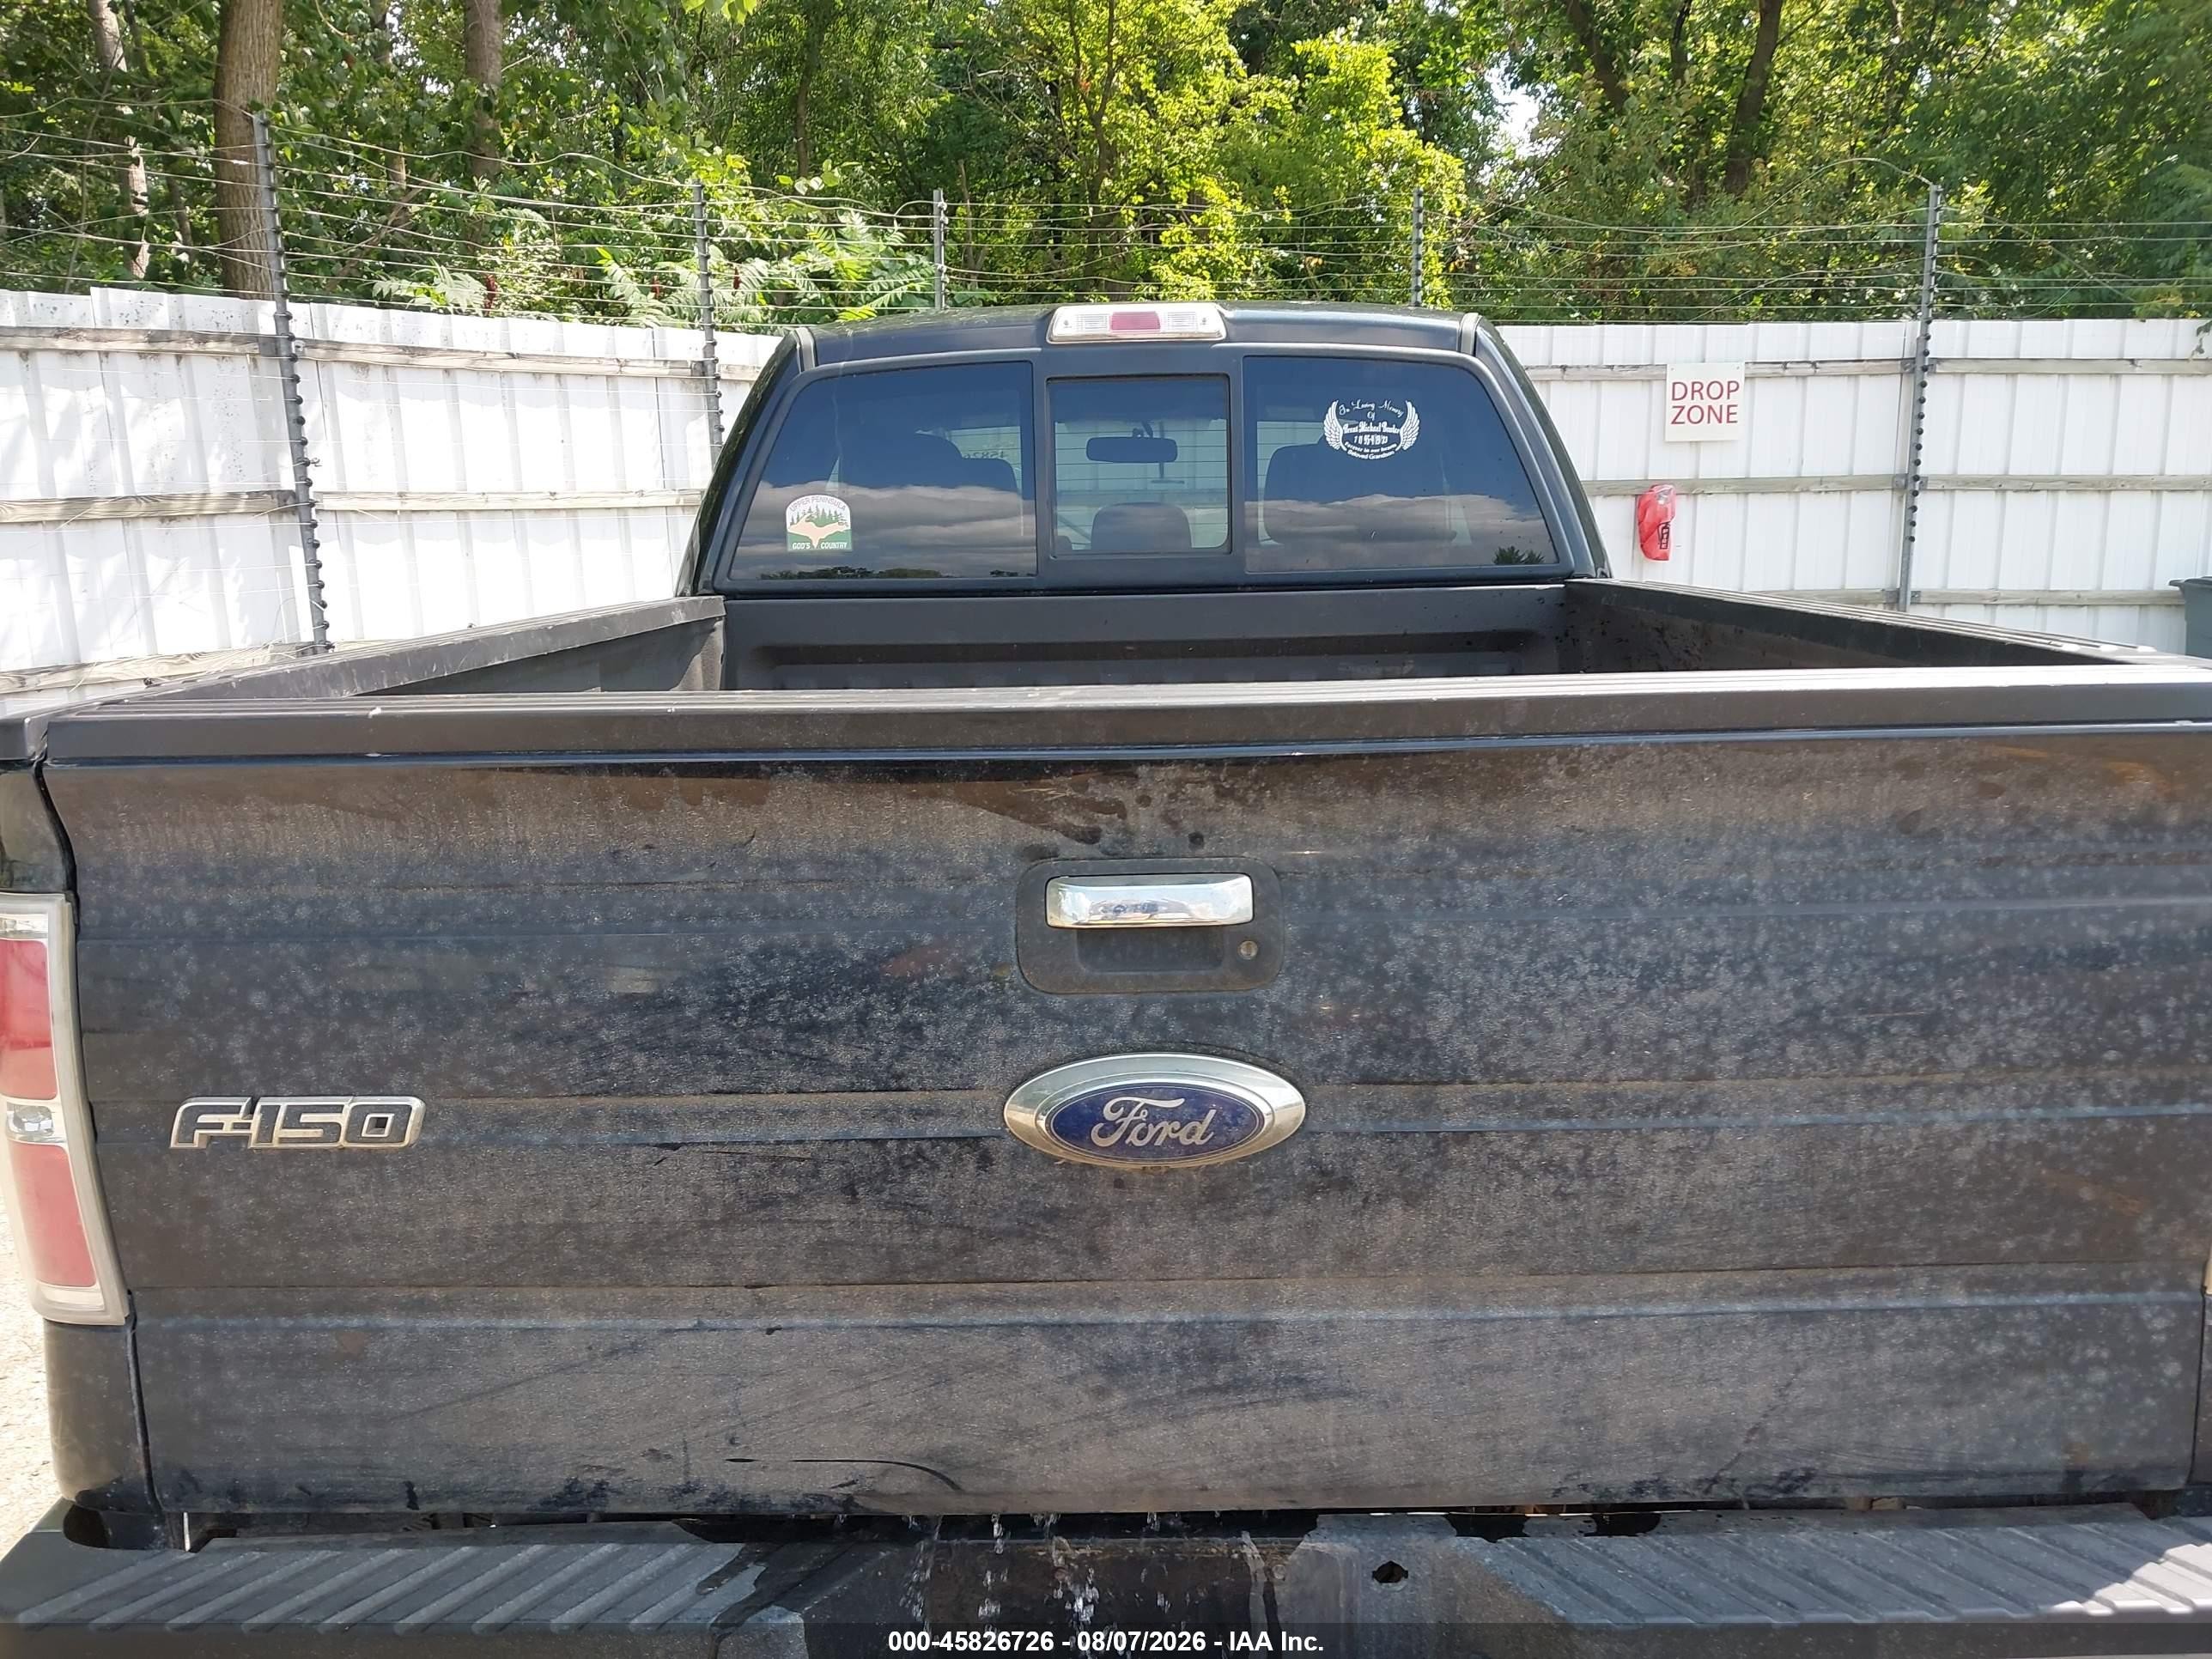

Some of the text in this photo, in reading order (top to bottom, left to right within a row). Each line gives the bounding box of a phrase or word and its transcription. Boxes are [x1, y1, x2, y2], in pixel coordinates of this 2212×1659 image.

[1671, 380, 1740, 401] DROP
[1351, 399, 1376, 410] Loving
[1378, 399, 1405, 418] Memory
[1670, 404, 1739, 425] ZONE
[1346, 449, 1369, 460] Beloved
[789, 495, 847, 512] UPPER PENINSULA
[169, 1096, 426, 1149] F-150
[1091, 1096, 1217, 1147] Ford
